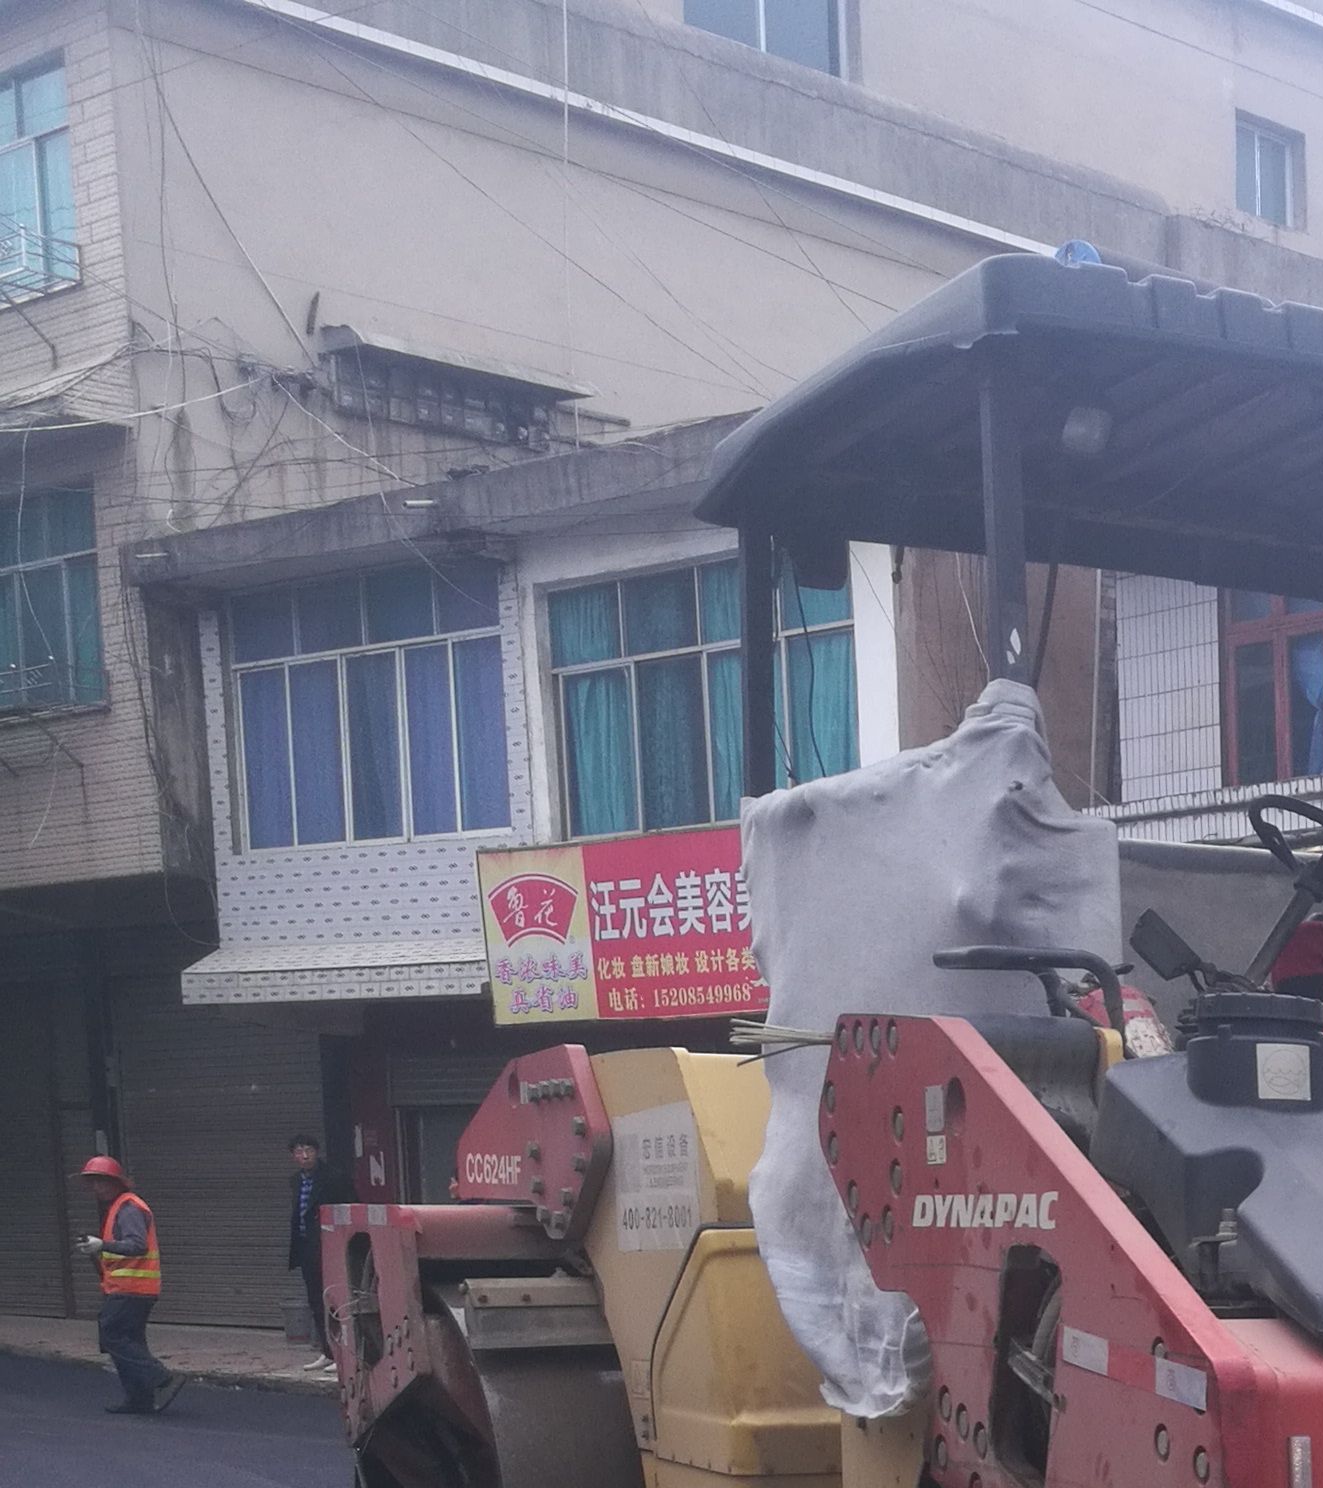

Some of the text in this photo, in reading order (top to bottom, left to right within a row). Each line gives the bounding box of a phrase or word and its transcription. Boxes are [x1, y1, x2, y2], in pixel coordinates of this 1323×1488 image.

[465, 1153, 522, 1185] CC624HF
[622, 1206, 692, 1231] 400-821-8001
[912, 1191, 1059, 1230] DYNAPAC
